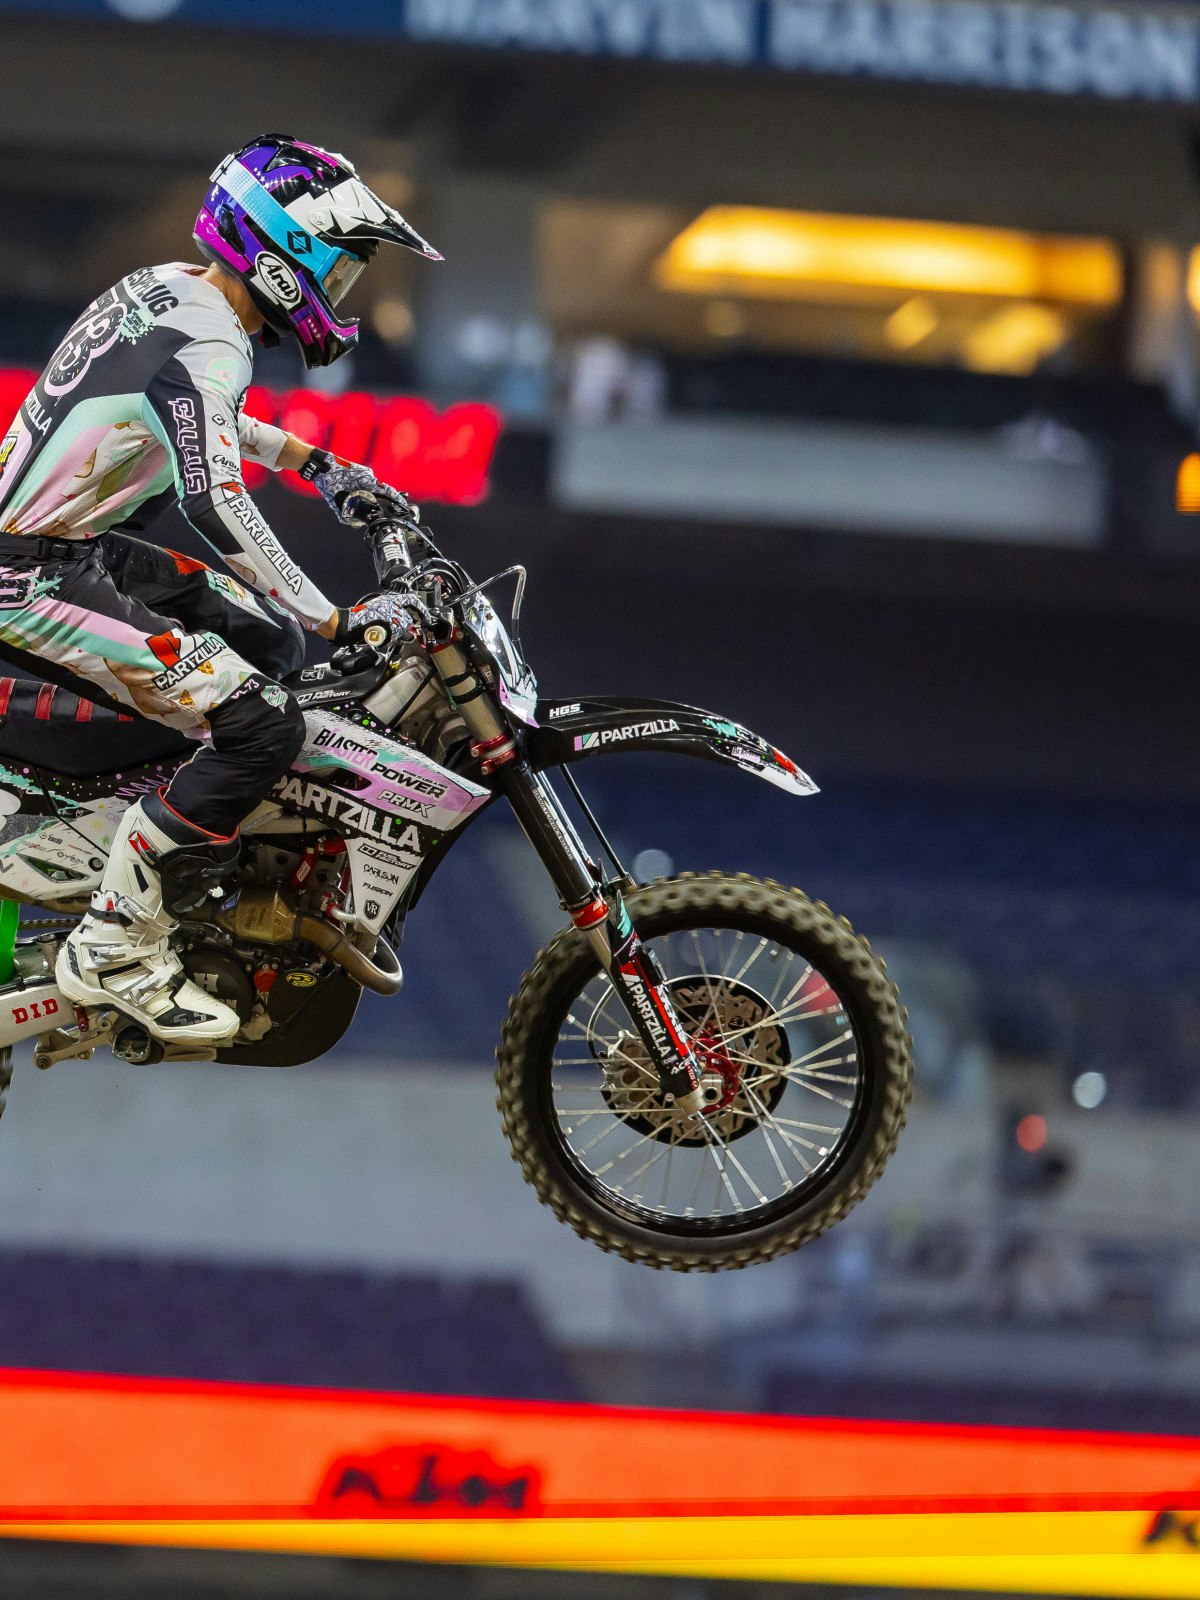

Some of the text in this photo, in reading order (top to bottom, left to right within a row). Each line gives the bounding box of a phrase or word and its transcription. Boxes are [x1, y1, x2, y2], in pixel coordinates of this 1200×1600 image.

[258, 259, 300, 299] Arai
[227, 496, 303, 596] PARTZILLA
[152, 634, 227, 691] PARTZILLA
[311, 690, 351, 701] FACTORY
[550, 703, 581, 719] HGS
[600, 718, 680, 745] PARTZILLA
[312, 727, 379, 770] BLASTER
[370, 762, 447, 799] POWER
[377, 788, 436, 819] PRMX
[362, 882, 394, 898] FUSION
[363, 863, 399, 886] CARLSON
[12, 998, 59, 1025] D.I.D
[630, 983, 672, 1058] PARTZILLA
